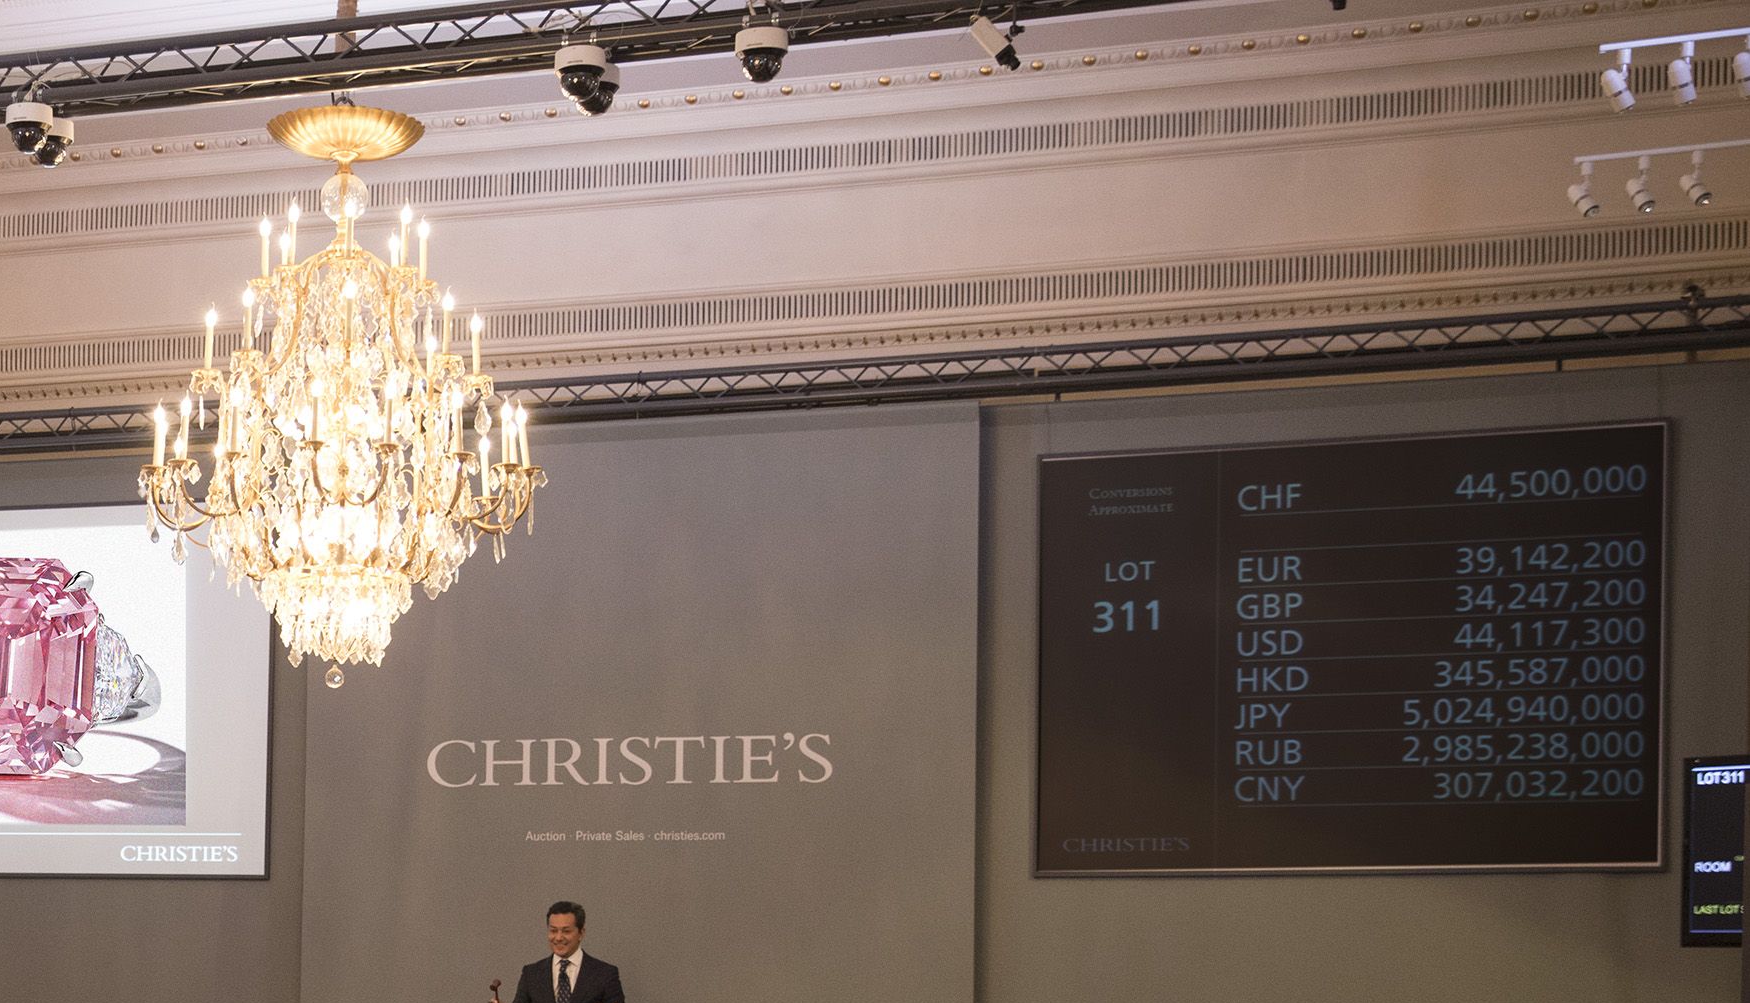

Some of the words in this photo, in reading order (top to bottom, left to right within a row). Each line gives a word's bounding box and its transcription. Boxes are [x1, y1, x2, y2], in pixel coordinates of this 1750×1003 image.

[1237, 484, 1302, 512] CHF
[1456, 465, 1646, 503] 44,500,000
[1105, 561, 1156, 582] LOT
[1237, 556, 1302, 583] EUR
[1456, 540, 1646, 578] 39,142,200
[1092, 600, 1160, 633] 311
[1236, 594, 1302, 621] GBP
[1455, 578, 1646, 615] 34,247,200
[1236, 630, 1302, 657] USD
[1453, 617, 1645, 652] 44,117,300
[1236, 666, 1309, 694] HKD
[1434, 655, 1645, 690] 345,587,000
[1235, 704, 1291, 729] JPY
[1402, 694, 1644, 728] 5,024,940,000
[426, 732, 834, 788] CHRISTIE'S
[1235, 740, 1301, 766] RUB
[1402, 732, 1643, 765] 2,985,238,000
[1234, 776, 1304, 802] CNY
[1433, 769, 1643, 801] 307,032,200
[525, 830, 566, 842] Auction
[575, 830, 612, 842] Private
[615, 830, 645, 842] Sales
[654, 829, 726, 841] christies.com
[1062, 835, 1190, 853] CHRISTIE'S
[120, 845, 238, 863] CHRISTIE'S
[1694, 861, 1732, 873] ROOM
